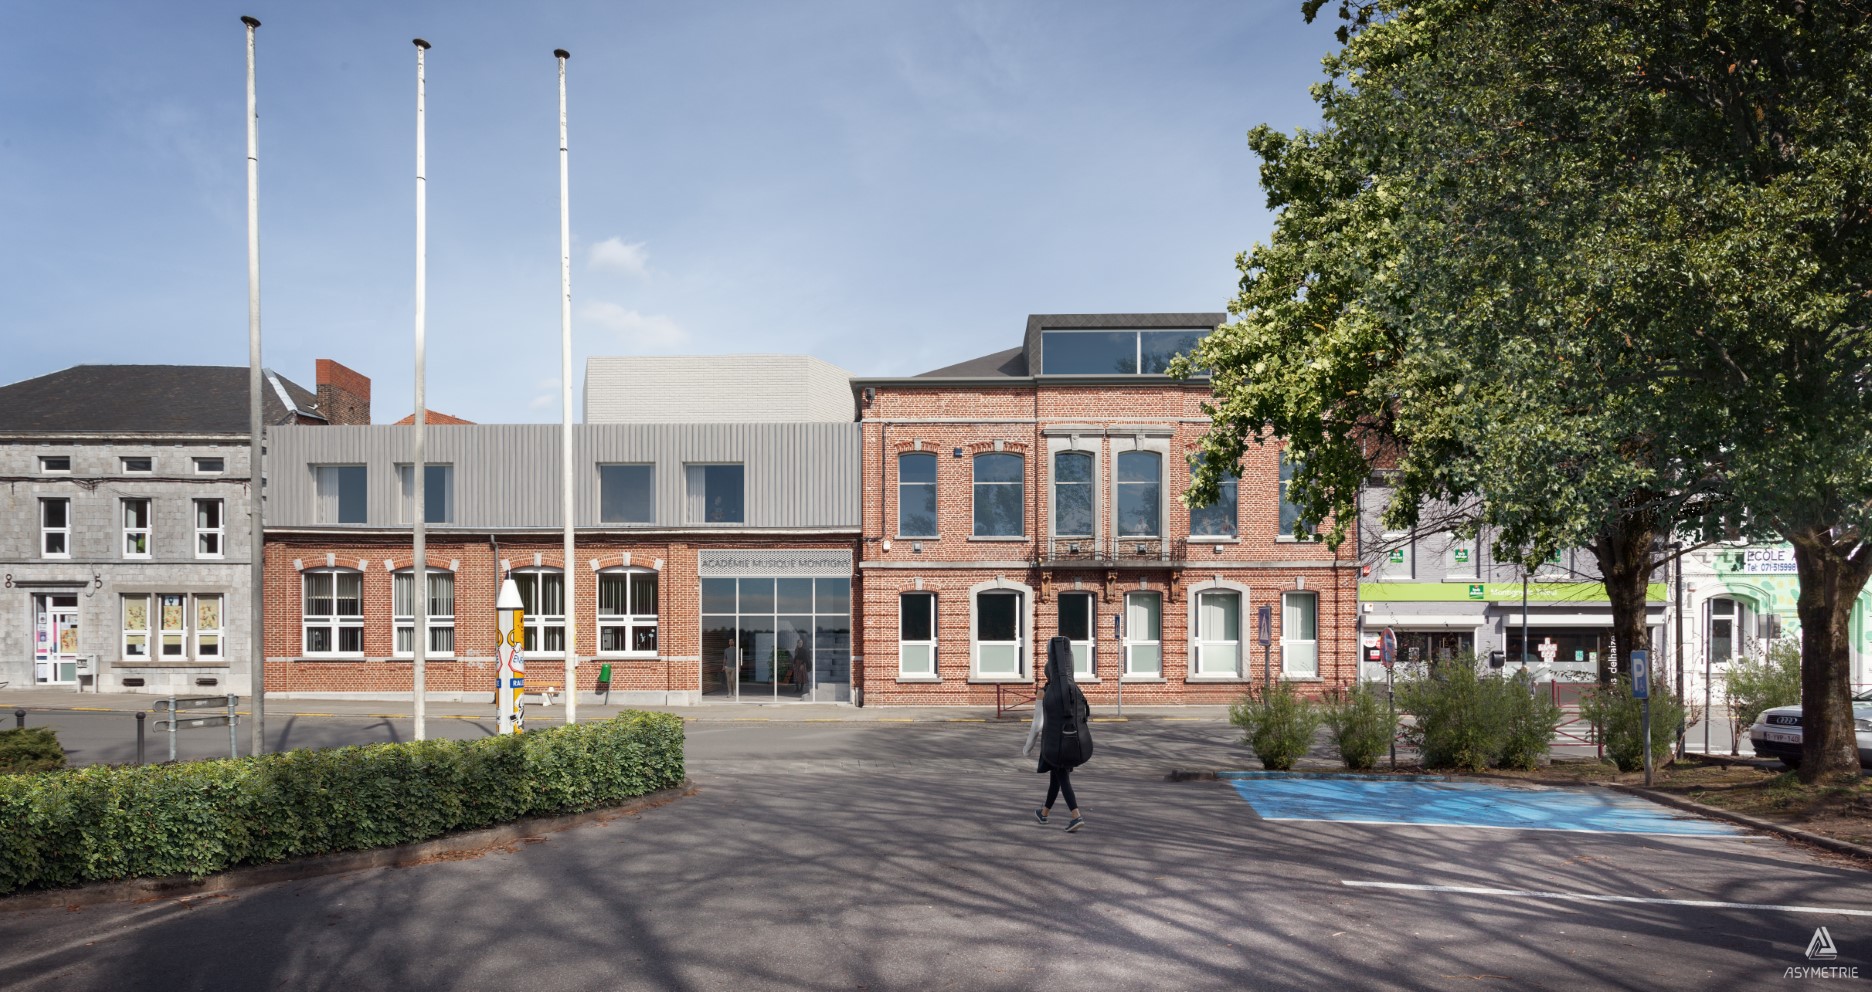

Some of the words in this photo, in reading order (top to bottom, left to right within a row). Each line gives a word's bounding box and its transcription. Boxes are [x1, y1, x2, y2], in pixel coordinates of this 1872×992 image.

[752, 559, 796, 568] MUSIQUE
[800, 559, 850, 568] MONTIGNY
[1633, 658, 1645, 691] P
